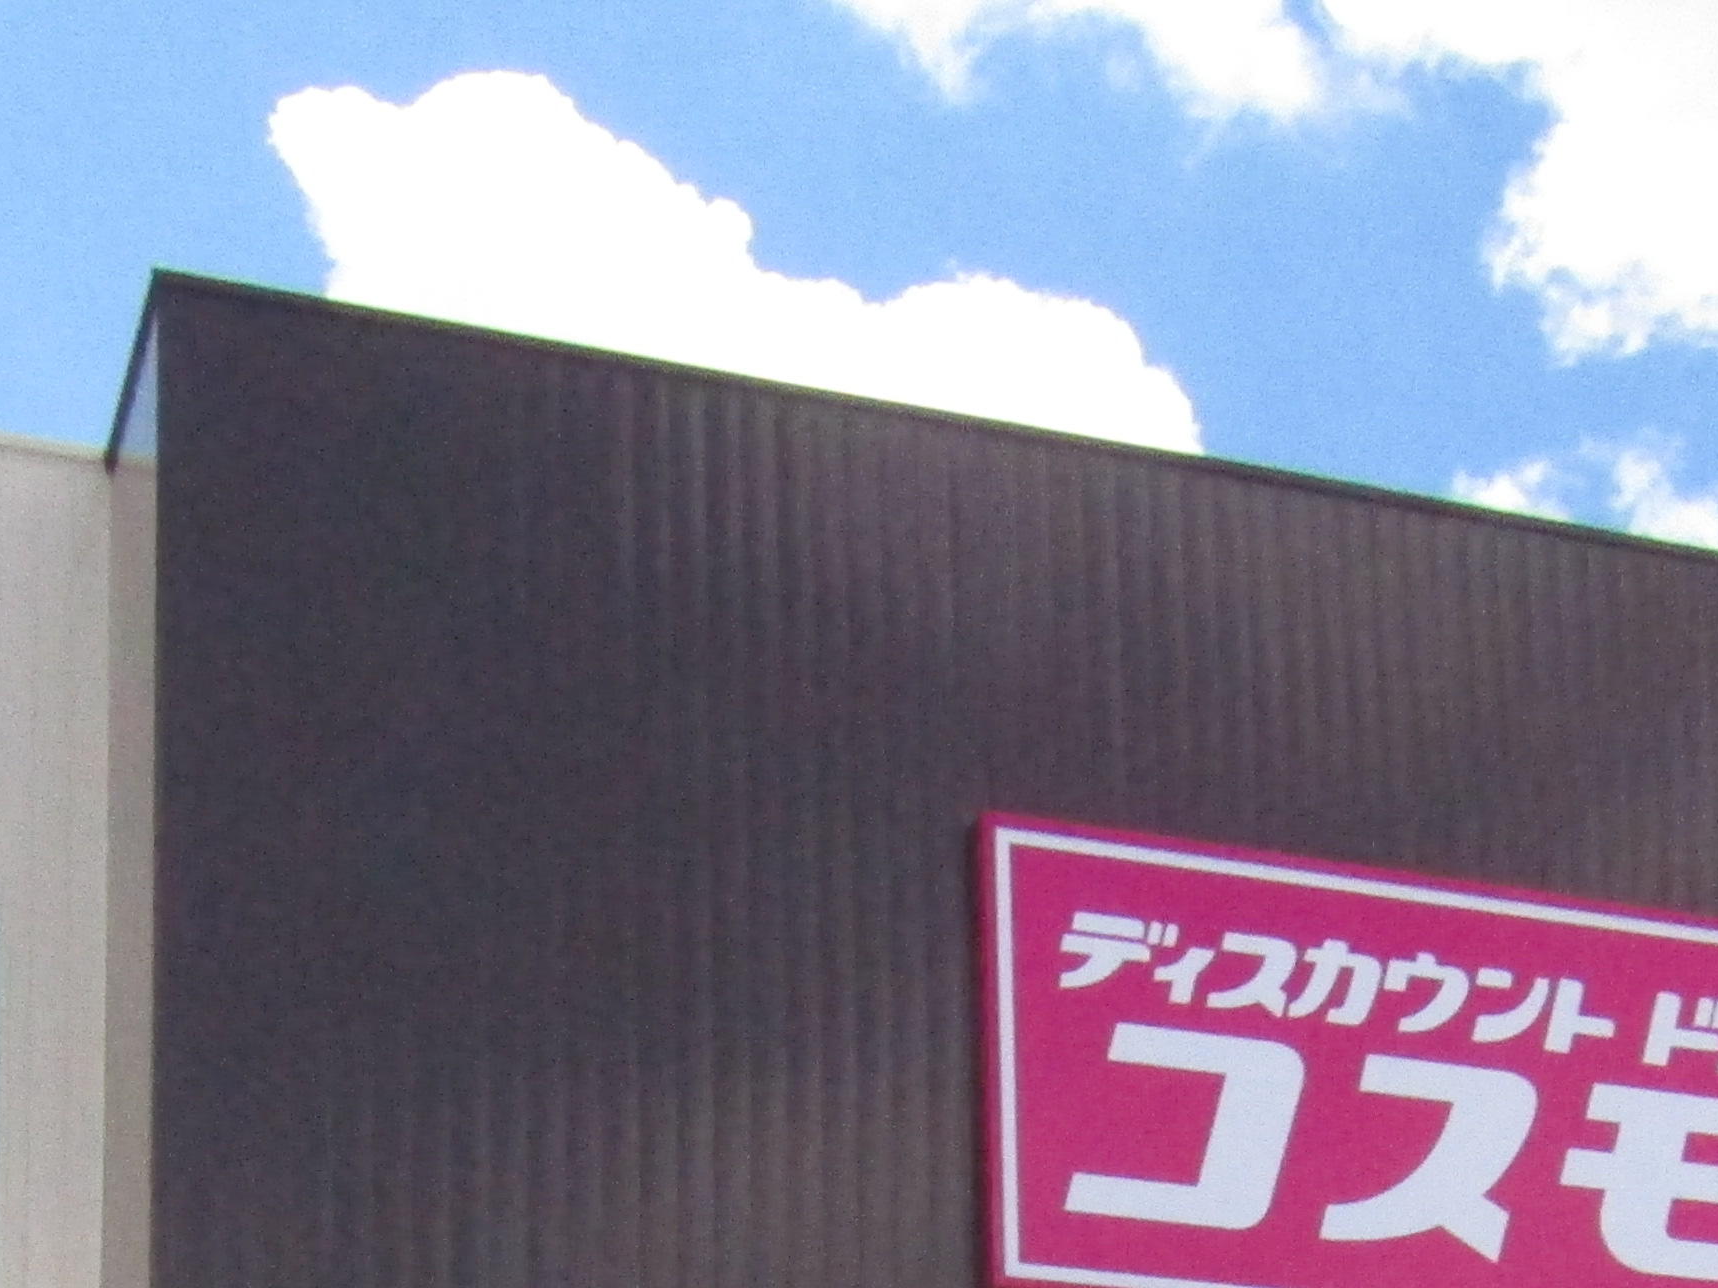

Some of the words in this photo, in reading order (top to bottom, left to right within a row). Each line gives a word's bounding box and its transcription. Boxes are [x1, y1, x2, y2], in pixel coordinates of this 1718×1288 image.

[1059, 911, 1616, 1054] ディスカウント
